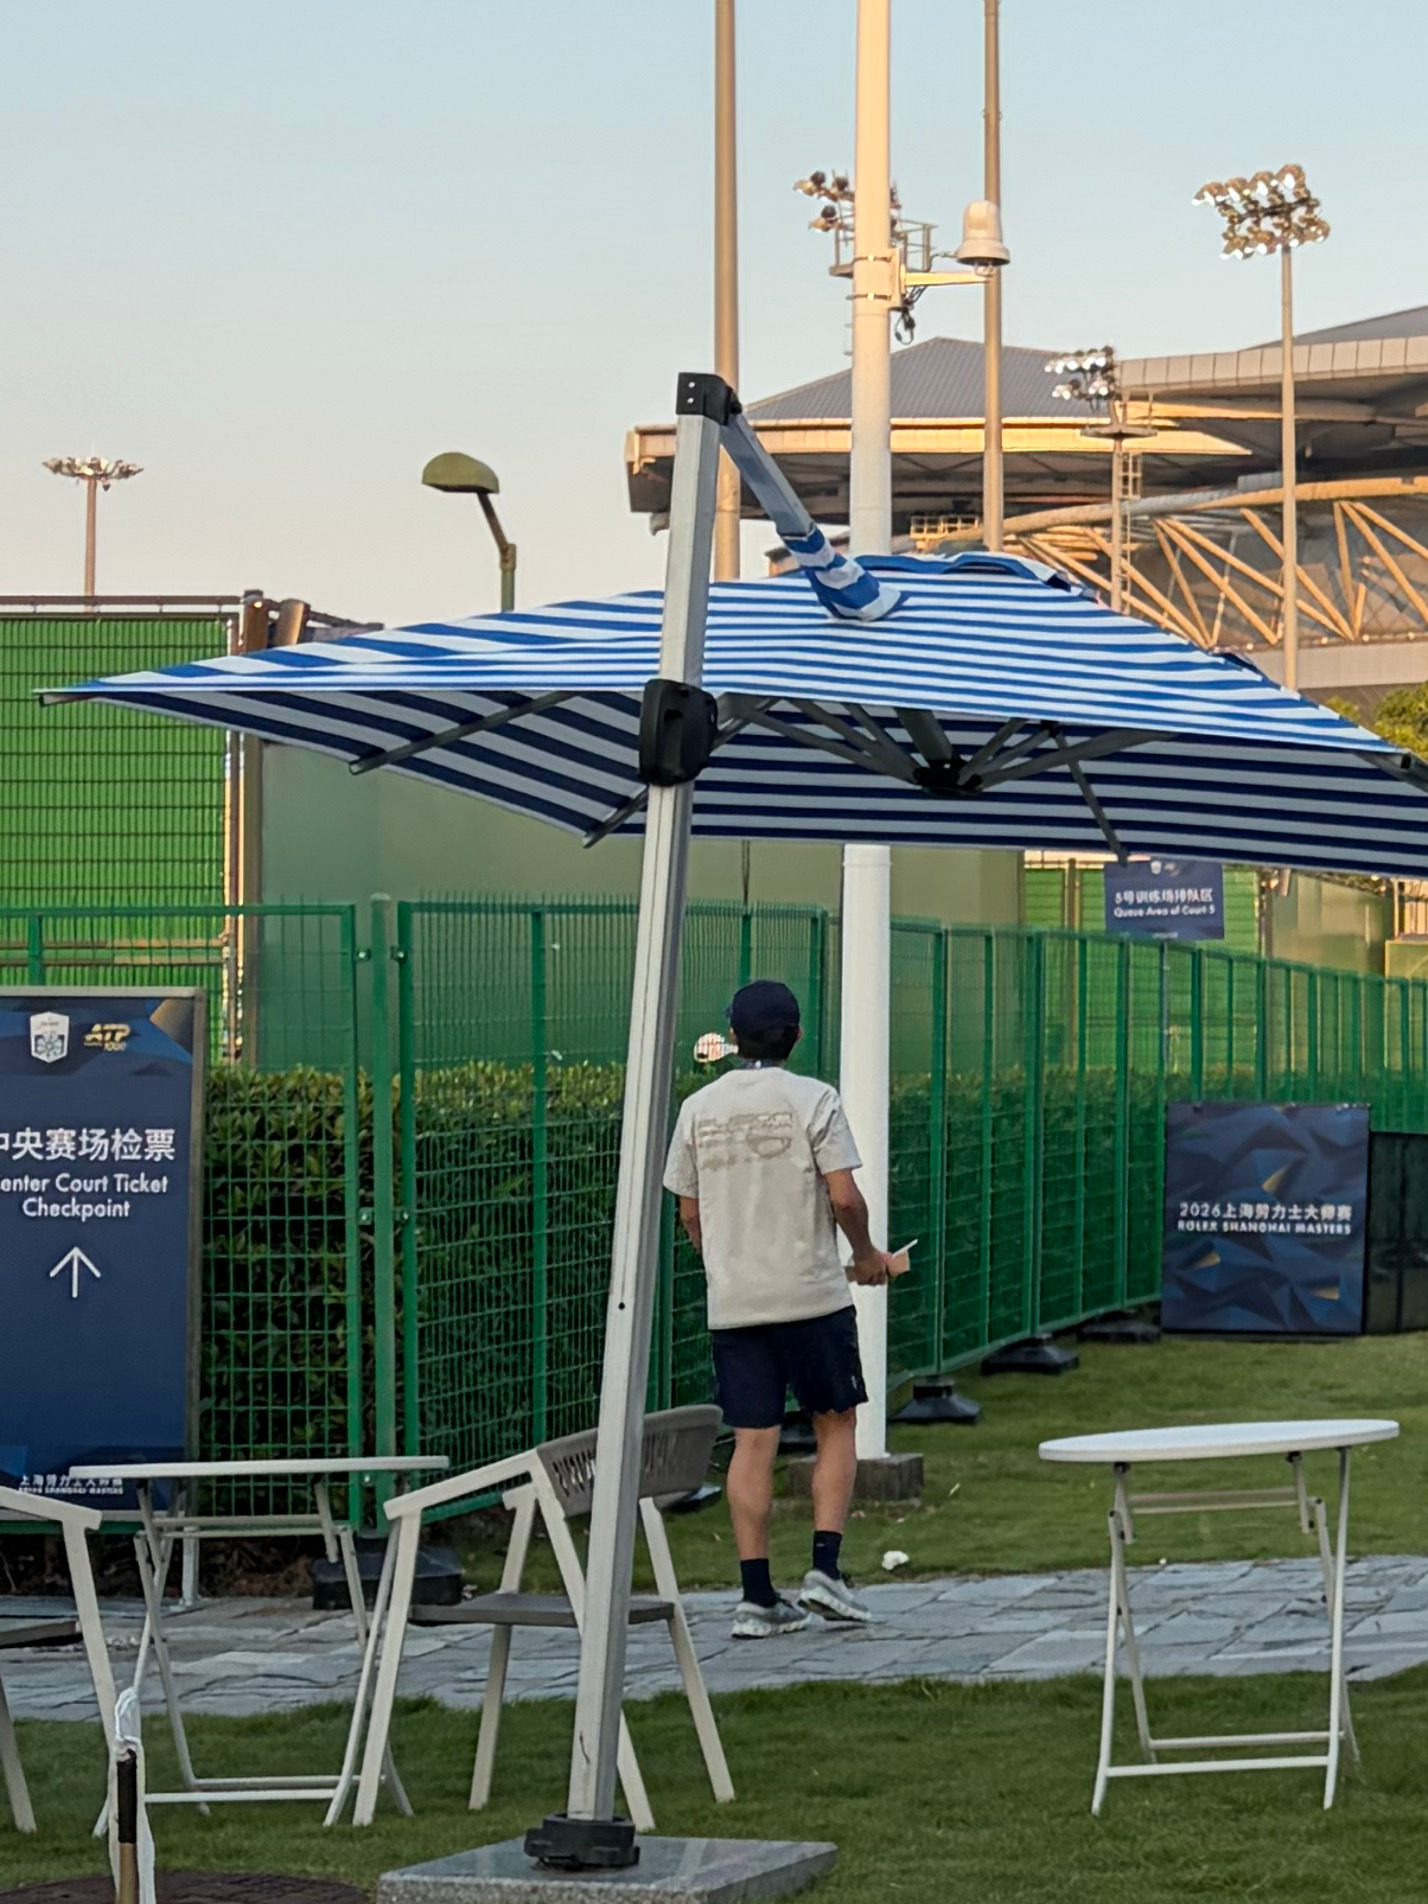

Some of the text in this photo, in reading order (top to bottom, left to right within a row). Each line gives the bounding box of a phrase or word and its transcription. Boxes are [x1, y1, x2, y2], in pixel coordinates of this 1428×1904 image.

[83, 1023, 131, 1043] ATP
[0, 1172, 168, 1193] enter Court Ticket
[22, 1197, 130, 1223] Checkpoint
[1178, 1219, 1352, 1235] ROLEX SHANGHAI MASTERS
